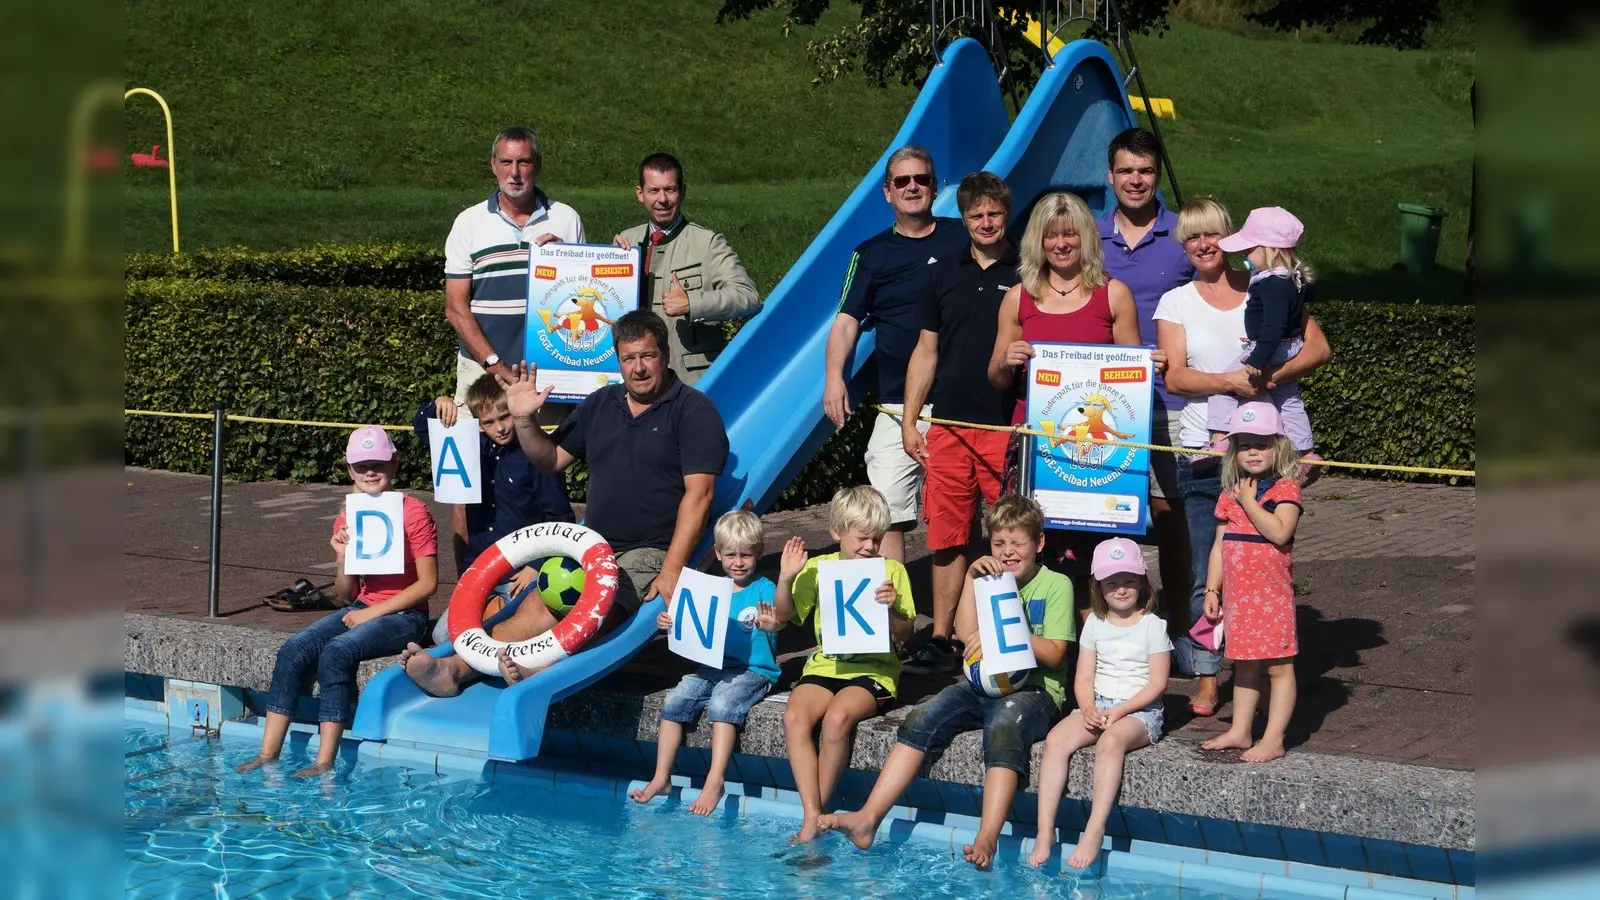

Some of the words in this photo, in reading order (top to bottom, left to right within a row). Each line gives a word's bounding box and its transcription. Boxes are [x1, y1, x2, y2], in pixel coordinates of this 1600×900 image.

[536, 268, 555, 277] NEU!
[556, 250, 584, 258] Freibad
[585, 250, 595, 258] ist
[596, 251, 629, 260] geöffnet!
[595, 266, 630, 275] BEHEIZT!
[540, 277, 566, 306] Badespaß
[566, 276, 576, 284] für
[578, 274, 588, 282] die
[590, 278, 609, 291] ganze
[608, 286, 625, 311] Familie
[537, 329, 581, 367] EGGE-Freibad
[583, 346, 616, 367] Neuenhe
[1042, 350, 1058, 358] Das
[1060, 350, 1092, 360] Freibad
[1093, 351, 1105, 360] ist
[1105, 352, 1142, 363] geöffnet!
[1037, 373, 1059, 383] NEU!
[1104, 370, 1142, 380] BEHEIZT!
[1041, 384, 1072, 416] Badespaß
[1072, 381, 1084, 391] für
[1085, 380, 1097, 388] die
[1098, 383, 1119, 397] ganze
[1118, 393, 1136, 422] Familie
[435, 436, 472, 488] A
[1039, 443, 1088, 487] EGGE-Freibad
[1090, 447, 1137, 487] Neuenheerse
[355, 510, 394, 560] D
[511, 523, 588, 544] Freibad
[675, 587, 719, 650] N
[834, 577, 876, 637] K
[990, 591, 1028, 654] E
